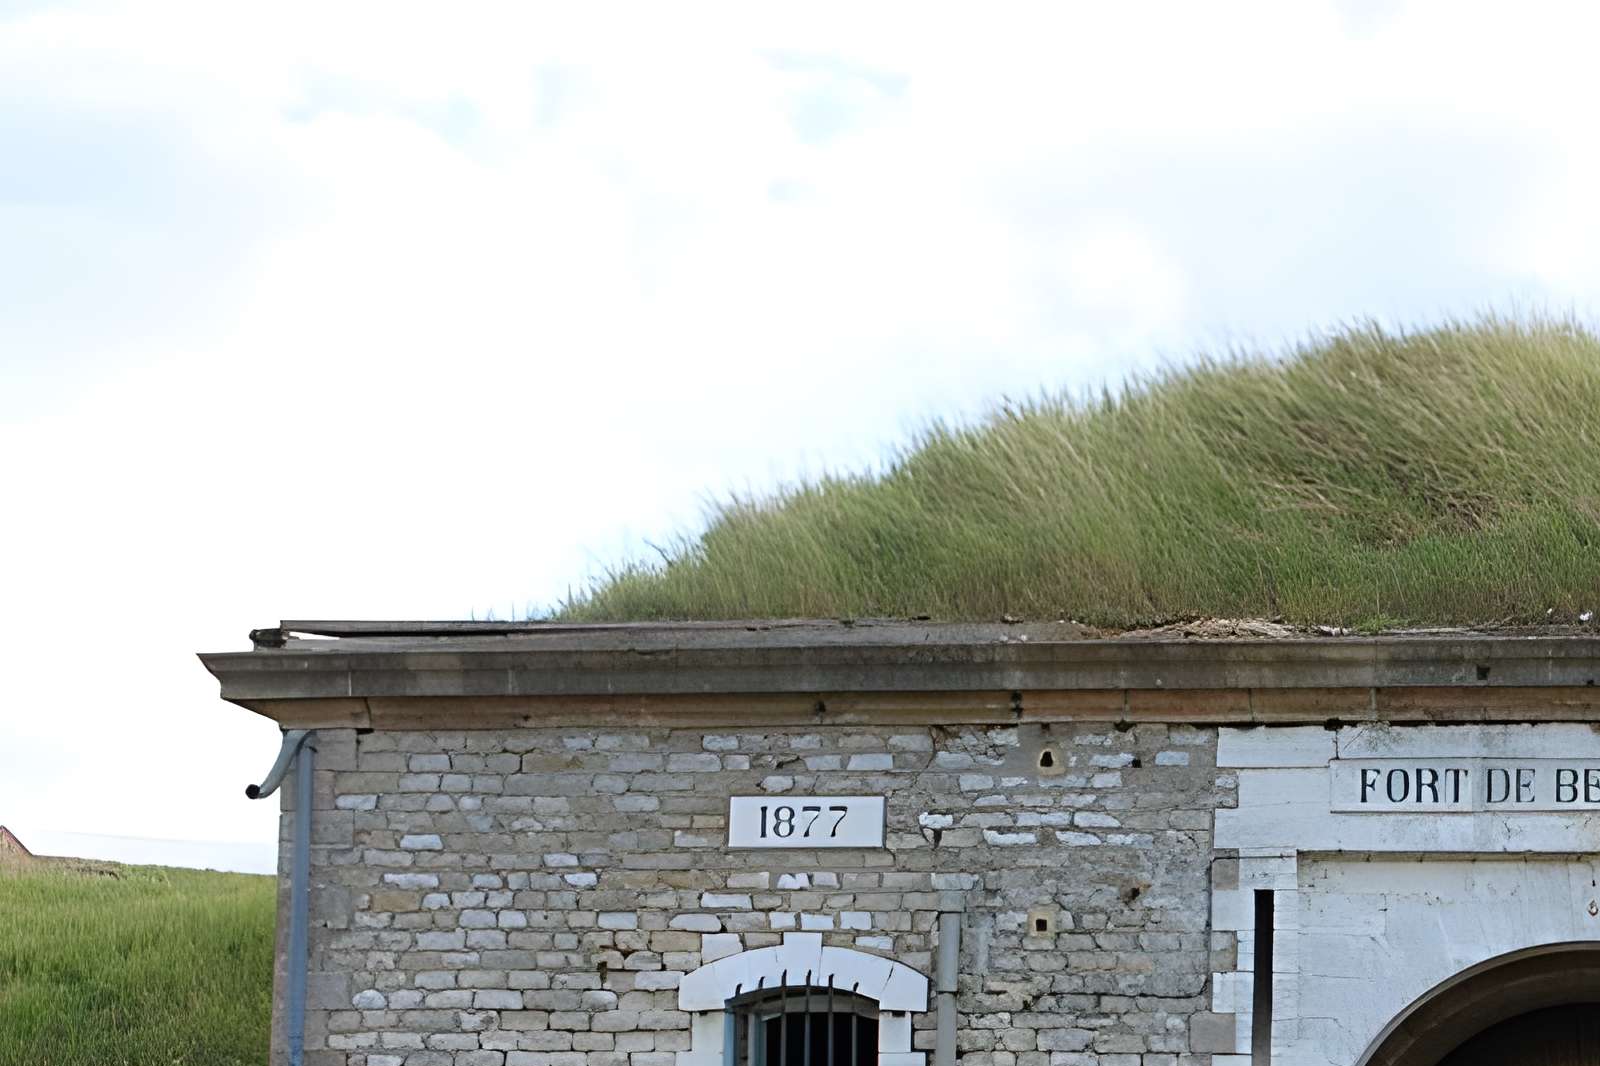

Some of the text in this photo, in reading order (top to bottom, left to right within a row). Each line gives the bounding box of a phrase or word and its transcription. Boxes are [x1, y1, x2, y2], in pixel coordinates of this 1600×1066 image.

[1360, 767, 1470, 804] FORT
[1486, 767, 1536, 804] DE
[759, 805, 849, 838] 1877
